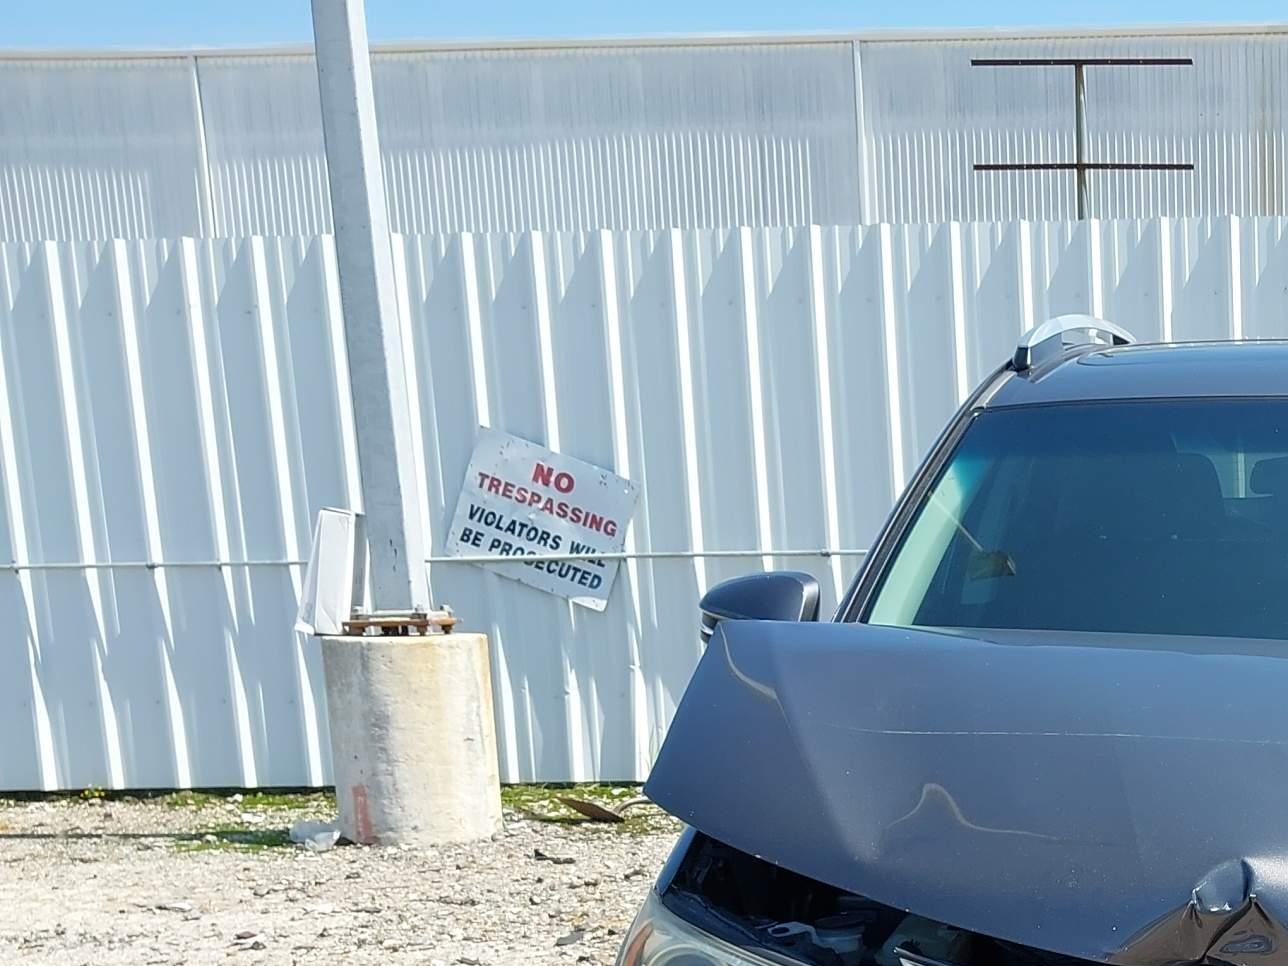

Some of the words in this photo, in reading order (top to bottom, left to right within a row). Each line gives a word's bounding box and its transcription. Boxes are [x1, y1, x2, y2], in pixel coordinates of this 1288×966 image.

[532, 463, 575, 493] NO
[478, 472, 617, 537] TRESPASSING
[460, 527, 484, 547] BE
[468, 504, 562, 550] VIOLATORS
